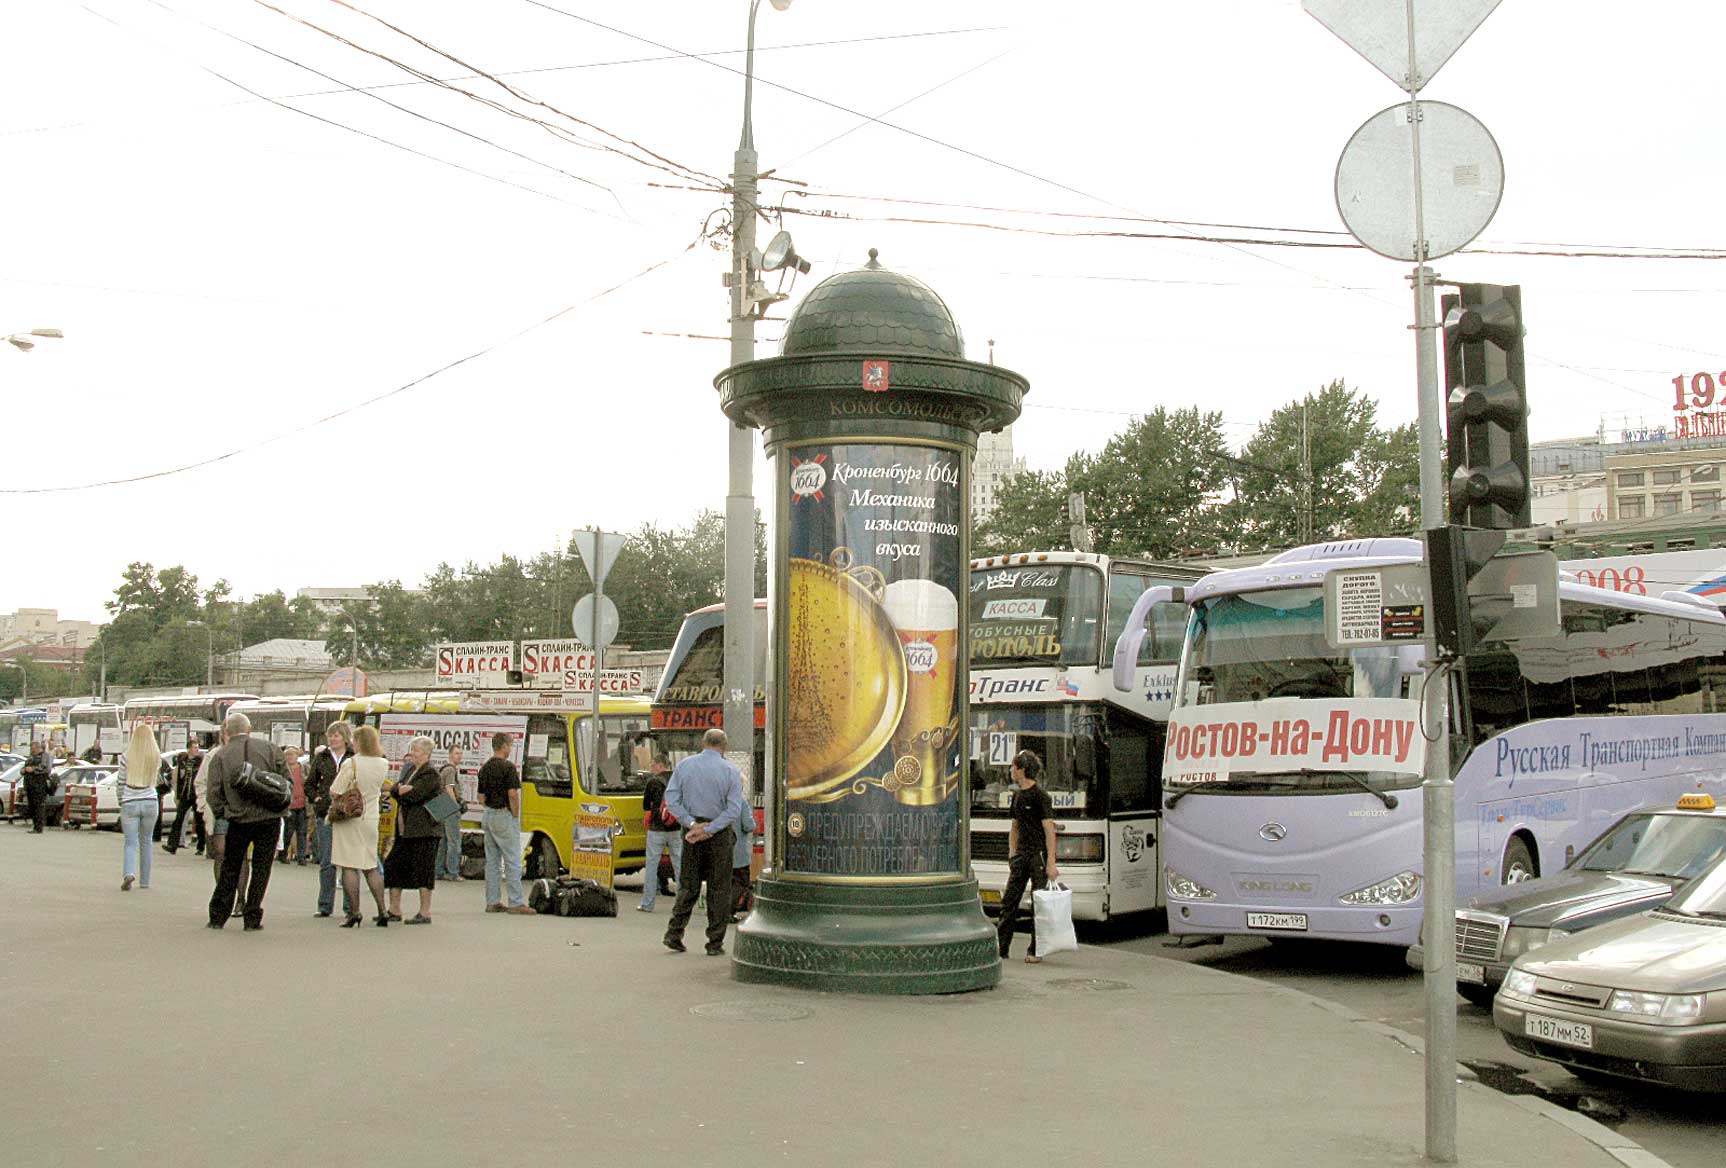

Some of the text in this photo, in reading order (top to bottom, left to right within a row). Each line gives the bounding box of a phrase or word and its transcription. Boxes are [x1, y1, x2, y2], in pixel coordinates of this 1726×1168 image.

[831, 461, 959, 488] Кроненбург 1664
[849, 489, 935, 508] Механика
[864, 519, 958, 536] изысканного
[875, 542, 921, 561] вкуса
[1021, 571, 1059, 588] Class
[989, 602, 1037, 615] КАССА
[456, 645, 509, 656] СПЛАЙН-ТРАНС
[970, 635, 1061, 658] РОПОЛЬ
[455, 656, 510, 674] КАССА
[1495, 737, 1570, 788] Русская
[1579, 732, 1679, 777] Транспортная
